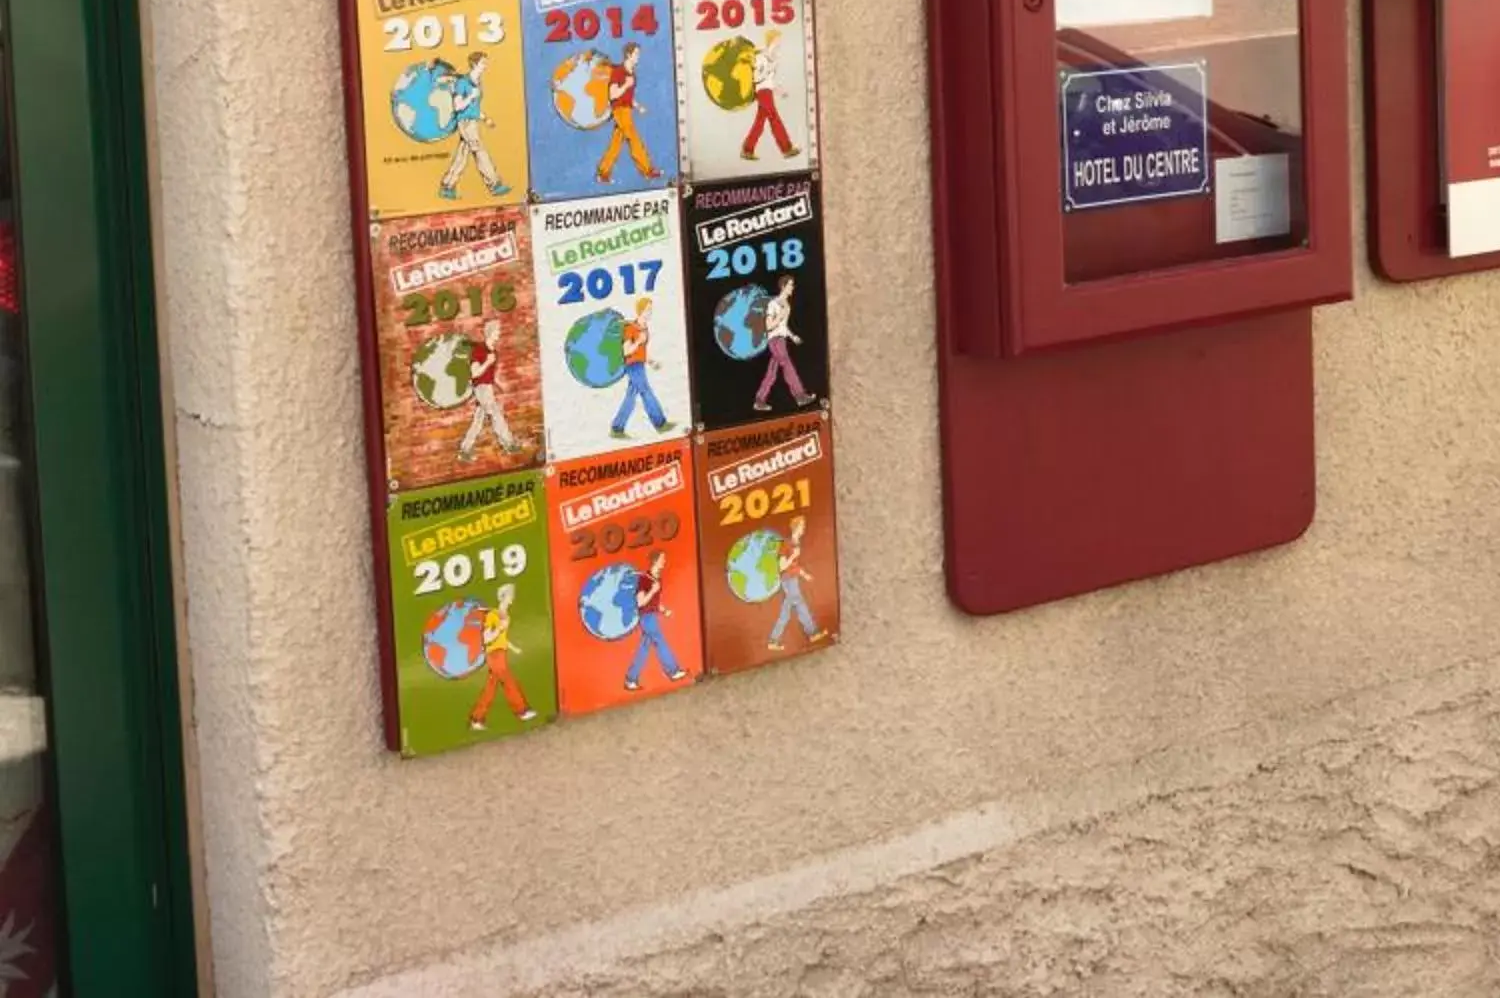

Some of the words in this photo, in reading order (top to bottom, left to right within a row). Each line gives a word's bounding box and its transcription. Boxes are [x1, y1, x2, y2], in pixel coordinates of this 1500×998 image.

[383, 11, 505, 52] 2013
[544, 3, 659, 43] 2014
[1095, 94, 1131, 113] Chez
[1135, 90, 1172, 110] Silvia
[1103, 120, 1117, 136] et
[1119, 113, 1171, 134] Jérôme
[1074, 156, 1120, 187] HOTEL
[1123, 154, 1143, 181] DU
[1146, 147, 1200, 179] CENTRE
[545, 198, 642, 231] RECOMMANDÉ
[700, 225, 726, 247] Le
[725, 197, 807, 239] Routard
[395, 269, 423, 291] Le
[424, 237, 513, 282] Routard
[551, 249, 577, 269] Le
[579, 216, 665, 260] Routard
[705, 238, 805, 280] 2018
[401, 281, 518, 327] 2016
[557, 258, 663, 305] 2017
[713, 473, 738, 494] Le
[737, 437, 817, 484] Routard
[401, 484, 504, 520] RECOMMANDÉ
[565, 505, 592, 526] Le
[591, 467, 678, 516] Routard
[719, 478, 811, 527] 2021
[408, 537, 437, 560] Le
[436, 499, 531, 549] Routard
[570, 510, 681, 562] 2020
[413, 543, 527, 596] 2019
